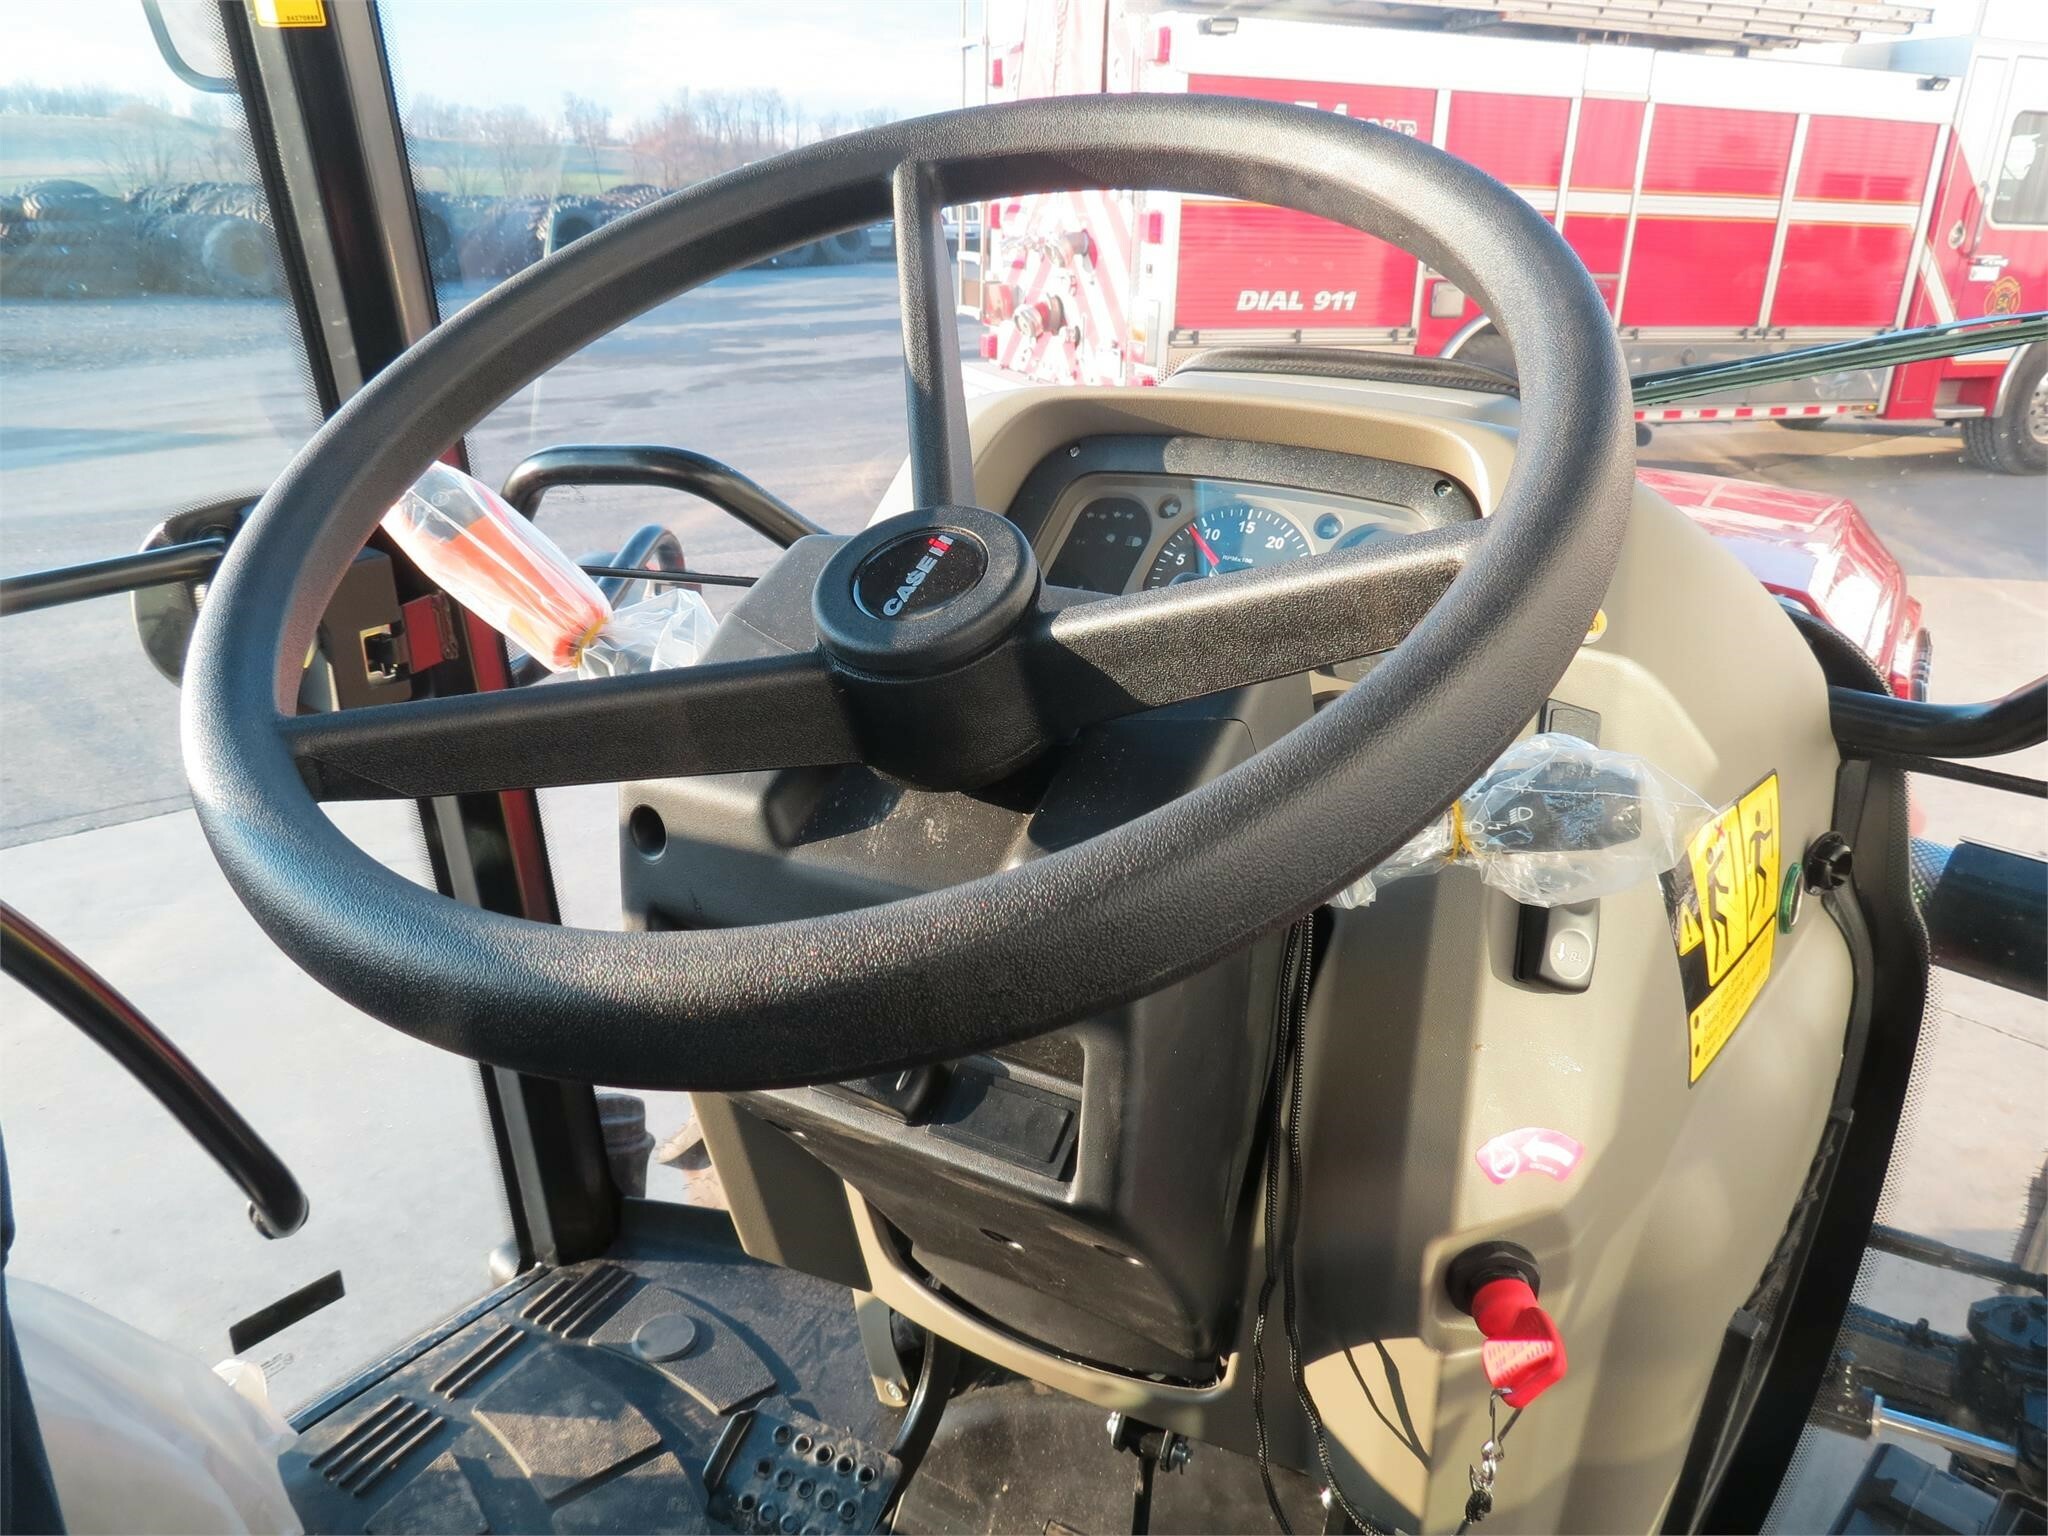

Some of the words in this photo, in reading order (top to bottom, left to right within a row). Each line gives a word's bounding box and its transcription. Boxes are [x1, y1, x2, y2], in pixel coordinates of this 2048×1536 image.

[1236, 290, 1304, 311] DIAL
[1312, 290, 1358, 311] 911
[1204, 527, 1221, 541] 10
[1239, 521, 1256, 534] 15
[1265, 536, 1285, 549] 20
[1176, 553, 1186, 565] 5
[882, 555, 938, 616] CASE
